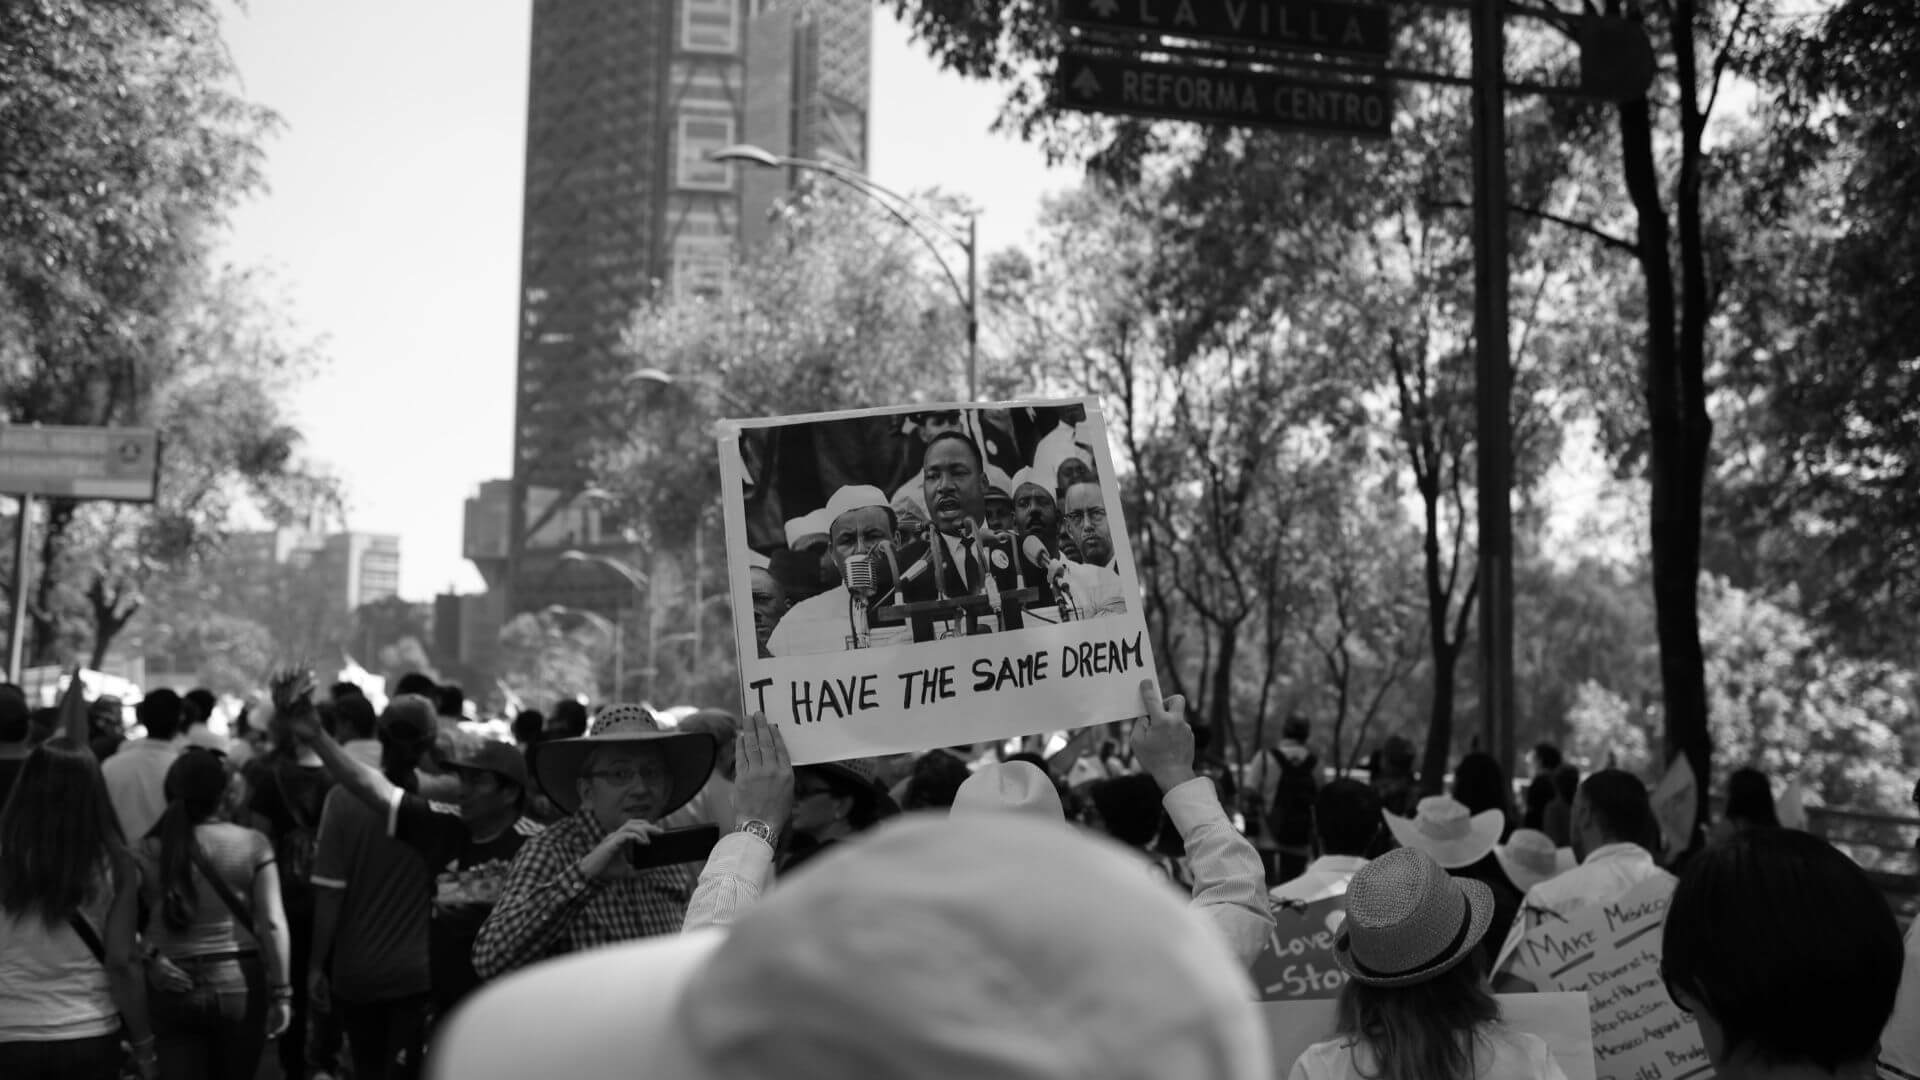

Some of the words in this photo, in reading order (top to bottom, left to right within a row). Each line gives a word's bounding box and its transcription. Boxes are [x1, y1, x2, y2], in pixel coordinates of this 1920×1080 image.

[1140, 0, 1197, 28] LA
[1225, 0, 1364, 45] VILLA
[1120, 69, 1260, 114] REFORMA
[1274, 86, 1386, 128] CENTRO
[791, 674, 879, 724] HAVE
[898, 665, 956, 709] THE
[972, 650, 1049, 693] SAME
[1061, 631, 1144, 679] DREAM
[1527, 930, 1598, 967] MAKE
[1265, 963, 1350, 996] -Sto
